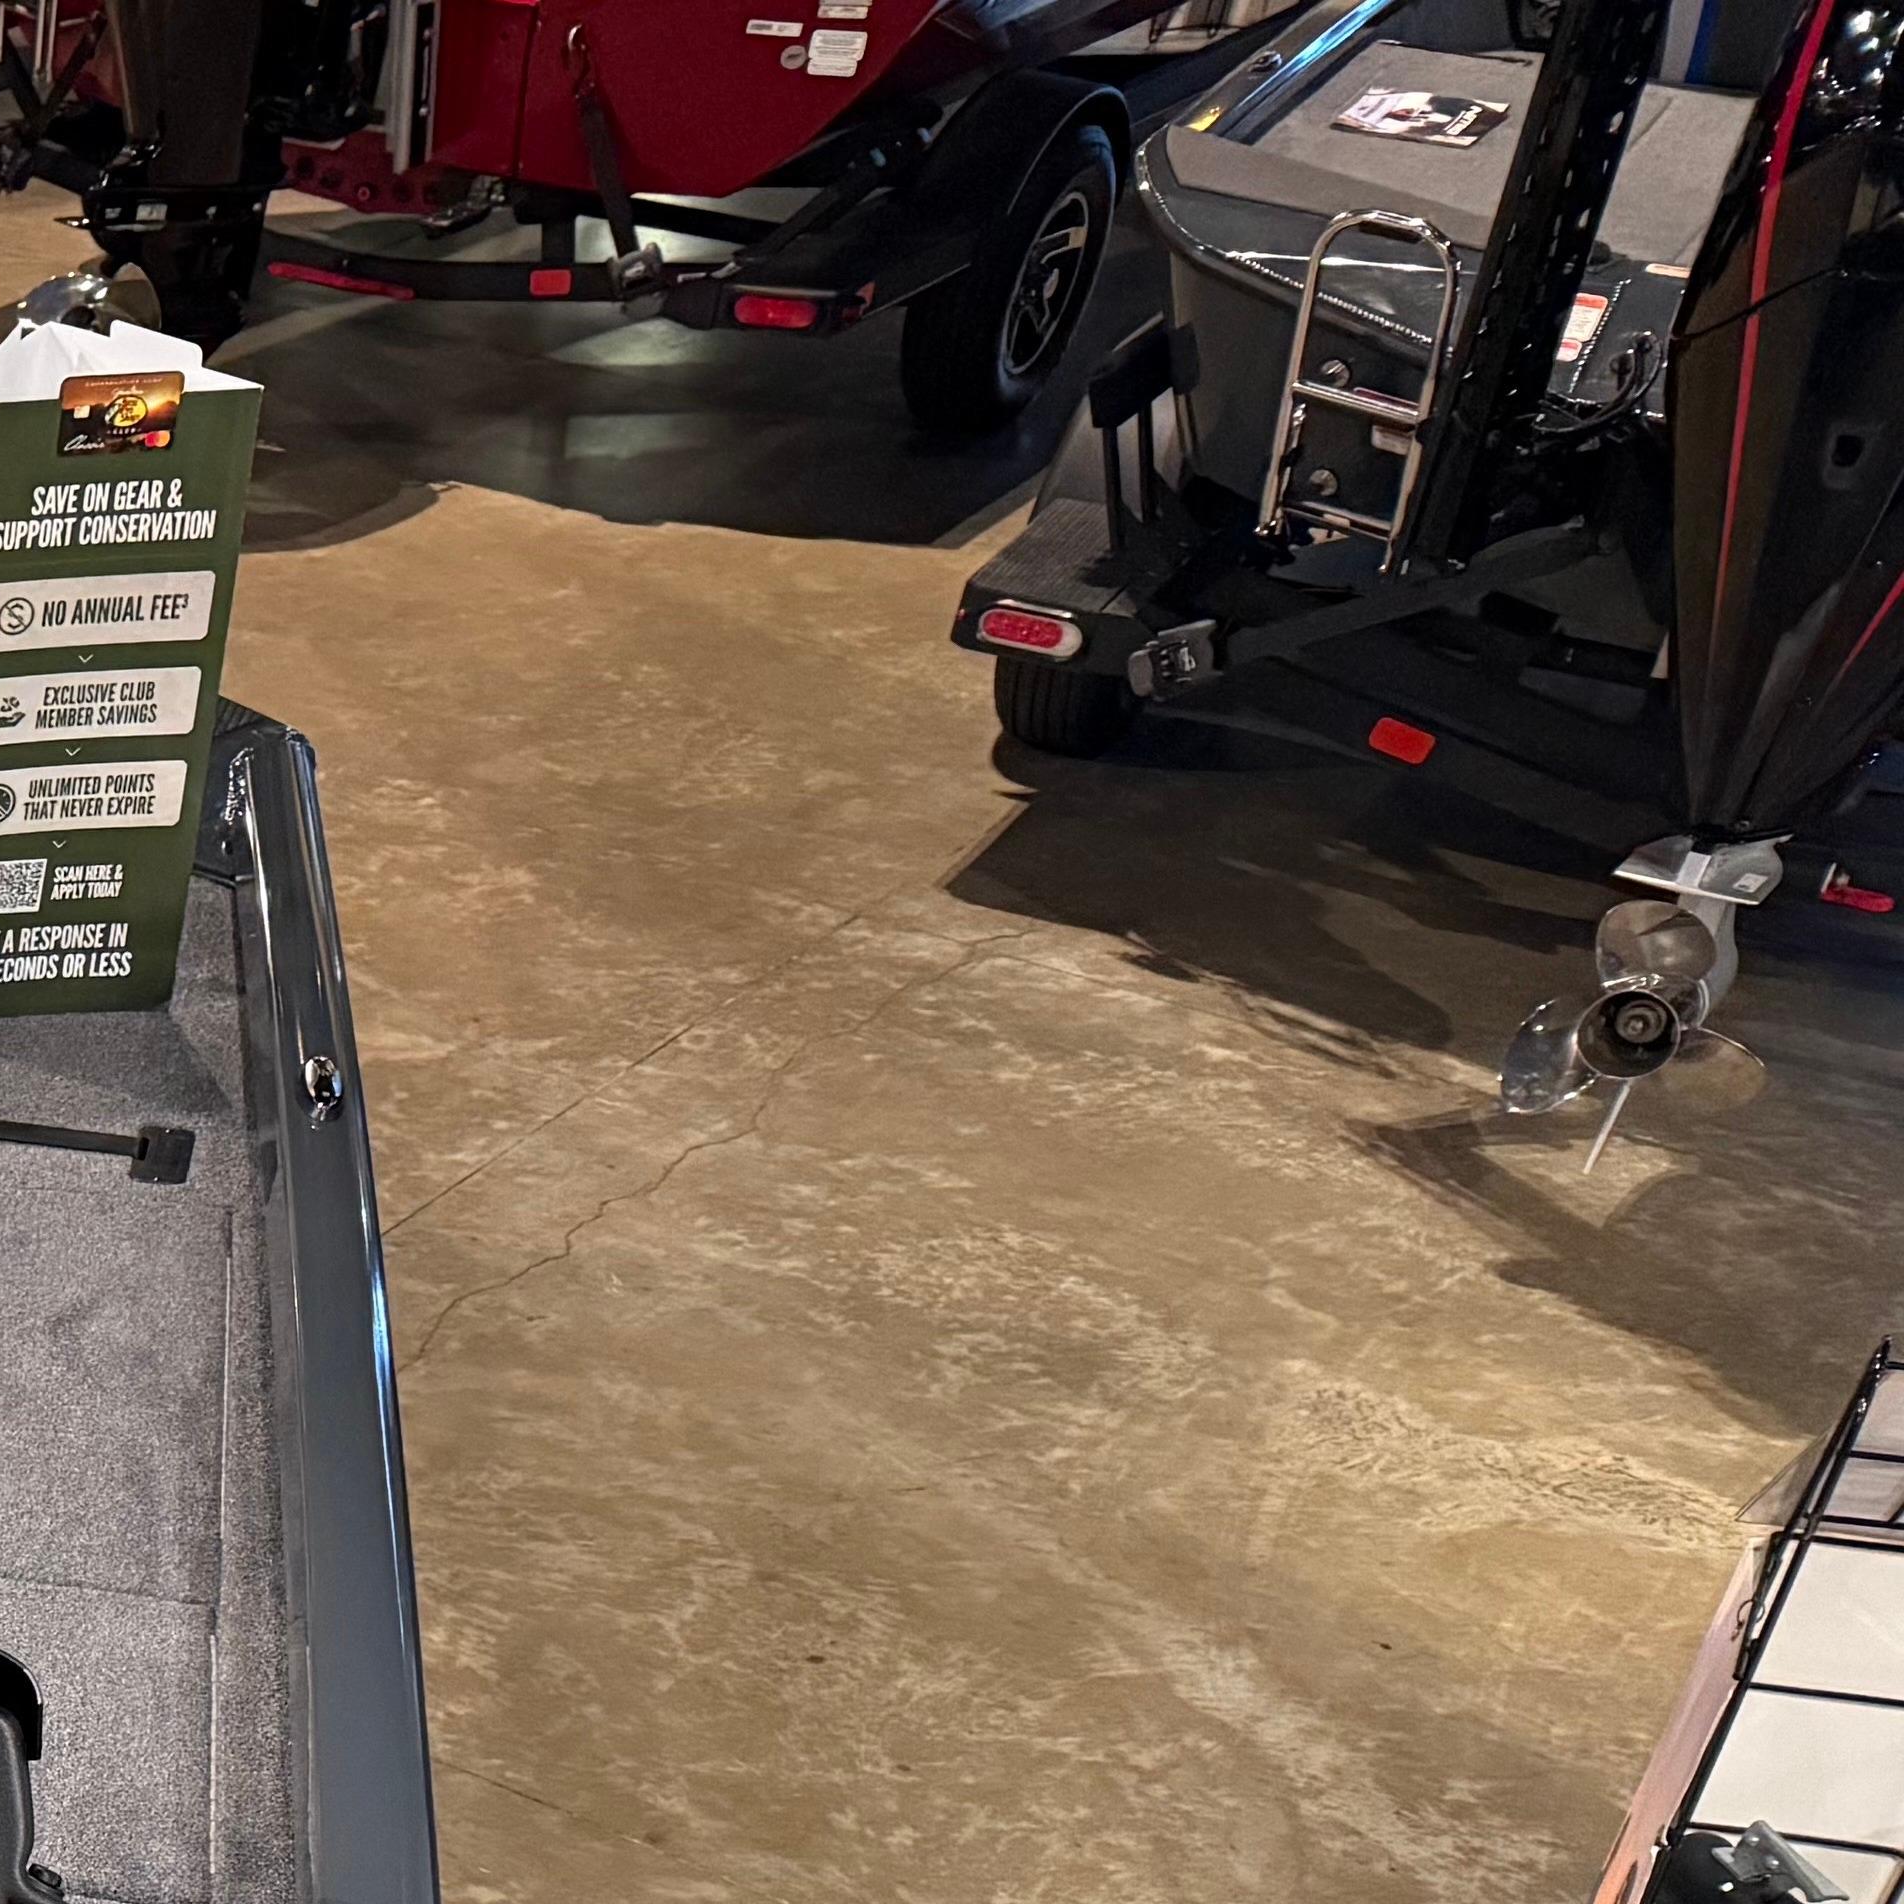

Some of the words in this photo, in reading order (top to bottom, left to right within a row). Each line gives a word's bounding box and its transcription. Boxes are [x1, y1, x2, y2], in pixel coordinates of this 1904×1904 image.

[31, 484, 80, 516] SAVE
[83, 482, 111, 513] ON
[113, 480, 164, 511] GEAR
[166, 478, 182, 507] &
[79, 510, 216, 546] CONSERVATION
[41, 600, 67, 627] NO
[71, 596, 145, 625] ANNUAL
[43, 683, 117, 706] EXCLUSIVE
[119, 681, 155, 702] CLUB
[35, 707, 94, 730] MEMBER
[97, 704, 158, 726] SAVINGS
[28, 776, 101, 799] UNLIMITED
[105, 773, 155, 794] POINTS
[23, 801, 58, 820] THAT
[60, 798, 104, 819] NEVER
[107, 795, 156, 816] EXPIRE
[53, 866, 84, 883] SCAN
[85, 865, 112, 881] HERE
[113, 864, 124, 880] &
[50, 882, 86, 900] APPLY
[87, 881, 123, 898] TODAY
[1, 929, 14, 954] A
[19, 923, 106, 952] RESPONSE
[108, 923, 129, 948] IN
[62, 954, 85, 978] OR
[89, 952, 133, 977] LESS
